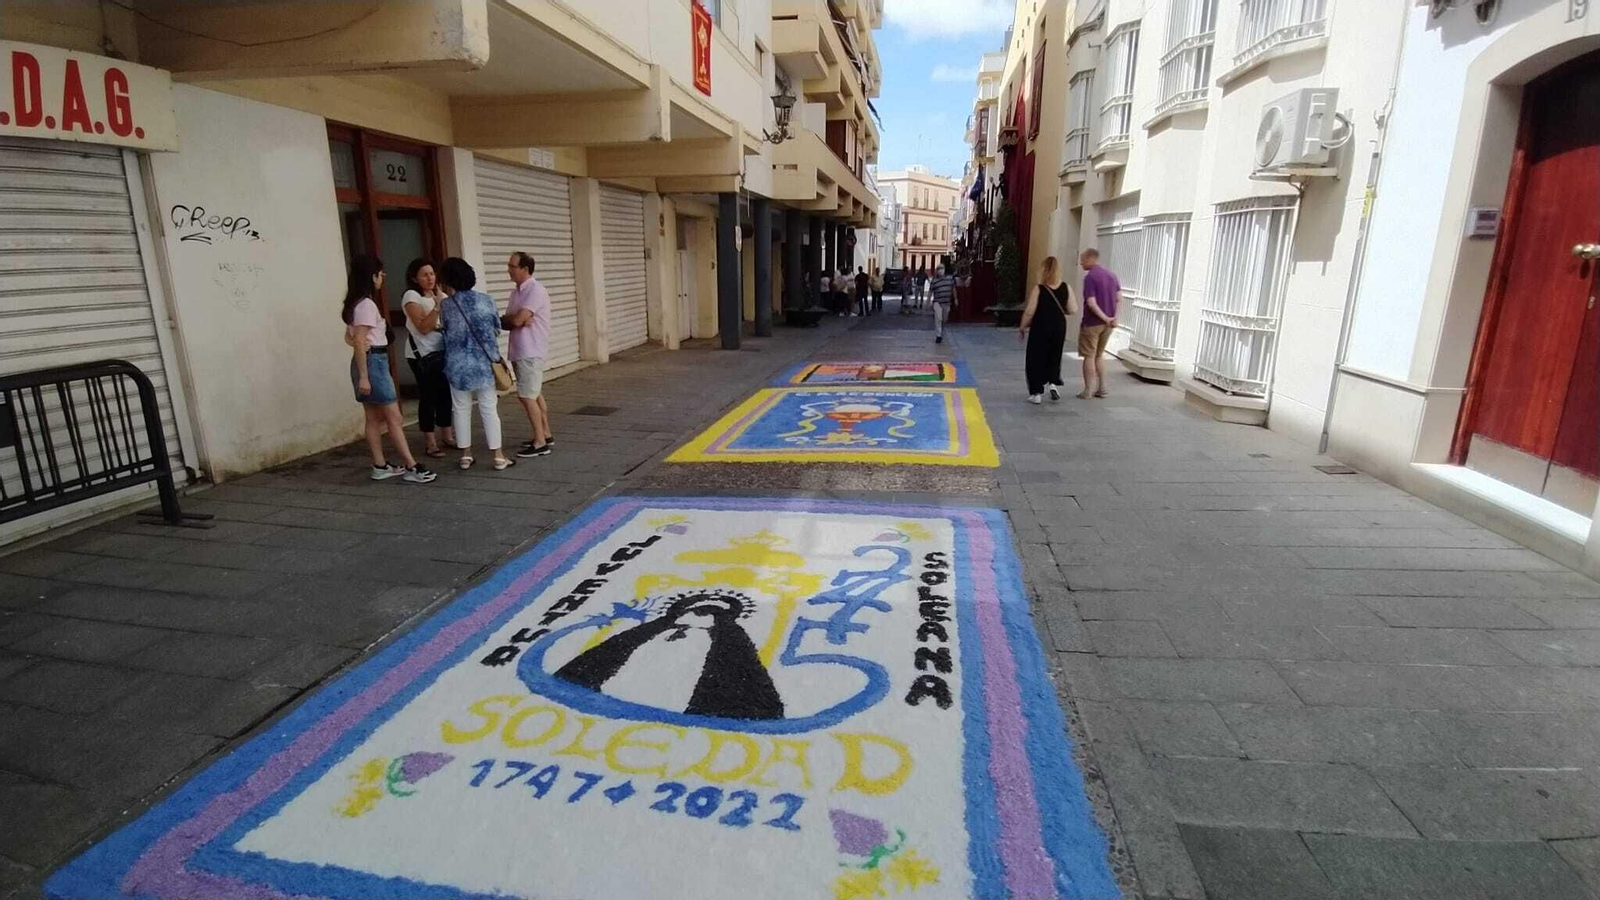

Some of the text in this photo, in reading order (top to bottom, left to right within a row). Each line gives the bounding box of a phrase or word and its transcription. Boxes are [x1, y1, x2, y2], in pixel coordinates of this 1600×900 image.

[1564, 0, 1588, 24] 19
[386, 163, 407, 182] 22
[904, 552, 954, 710] SOLEANA
[440, 694, 914, 796] SOLEDAD
[470, 758, 807, 832] 1747 2022
